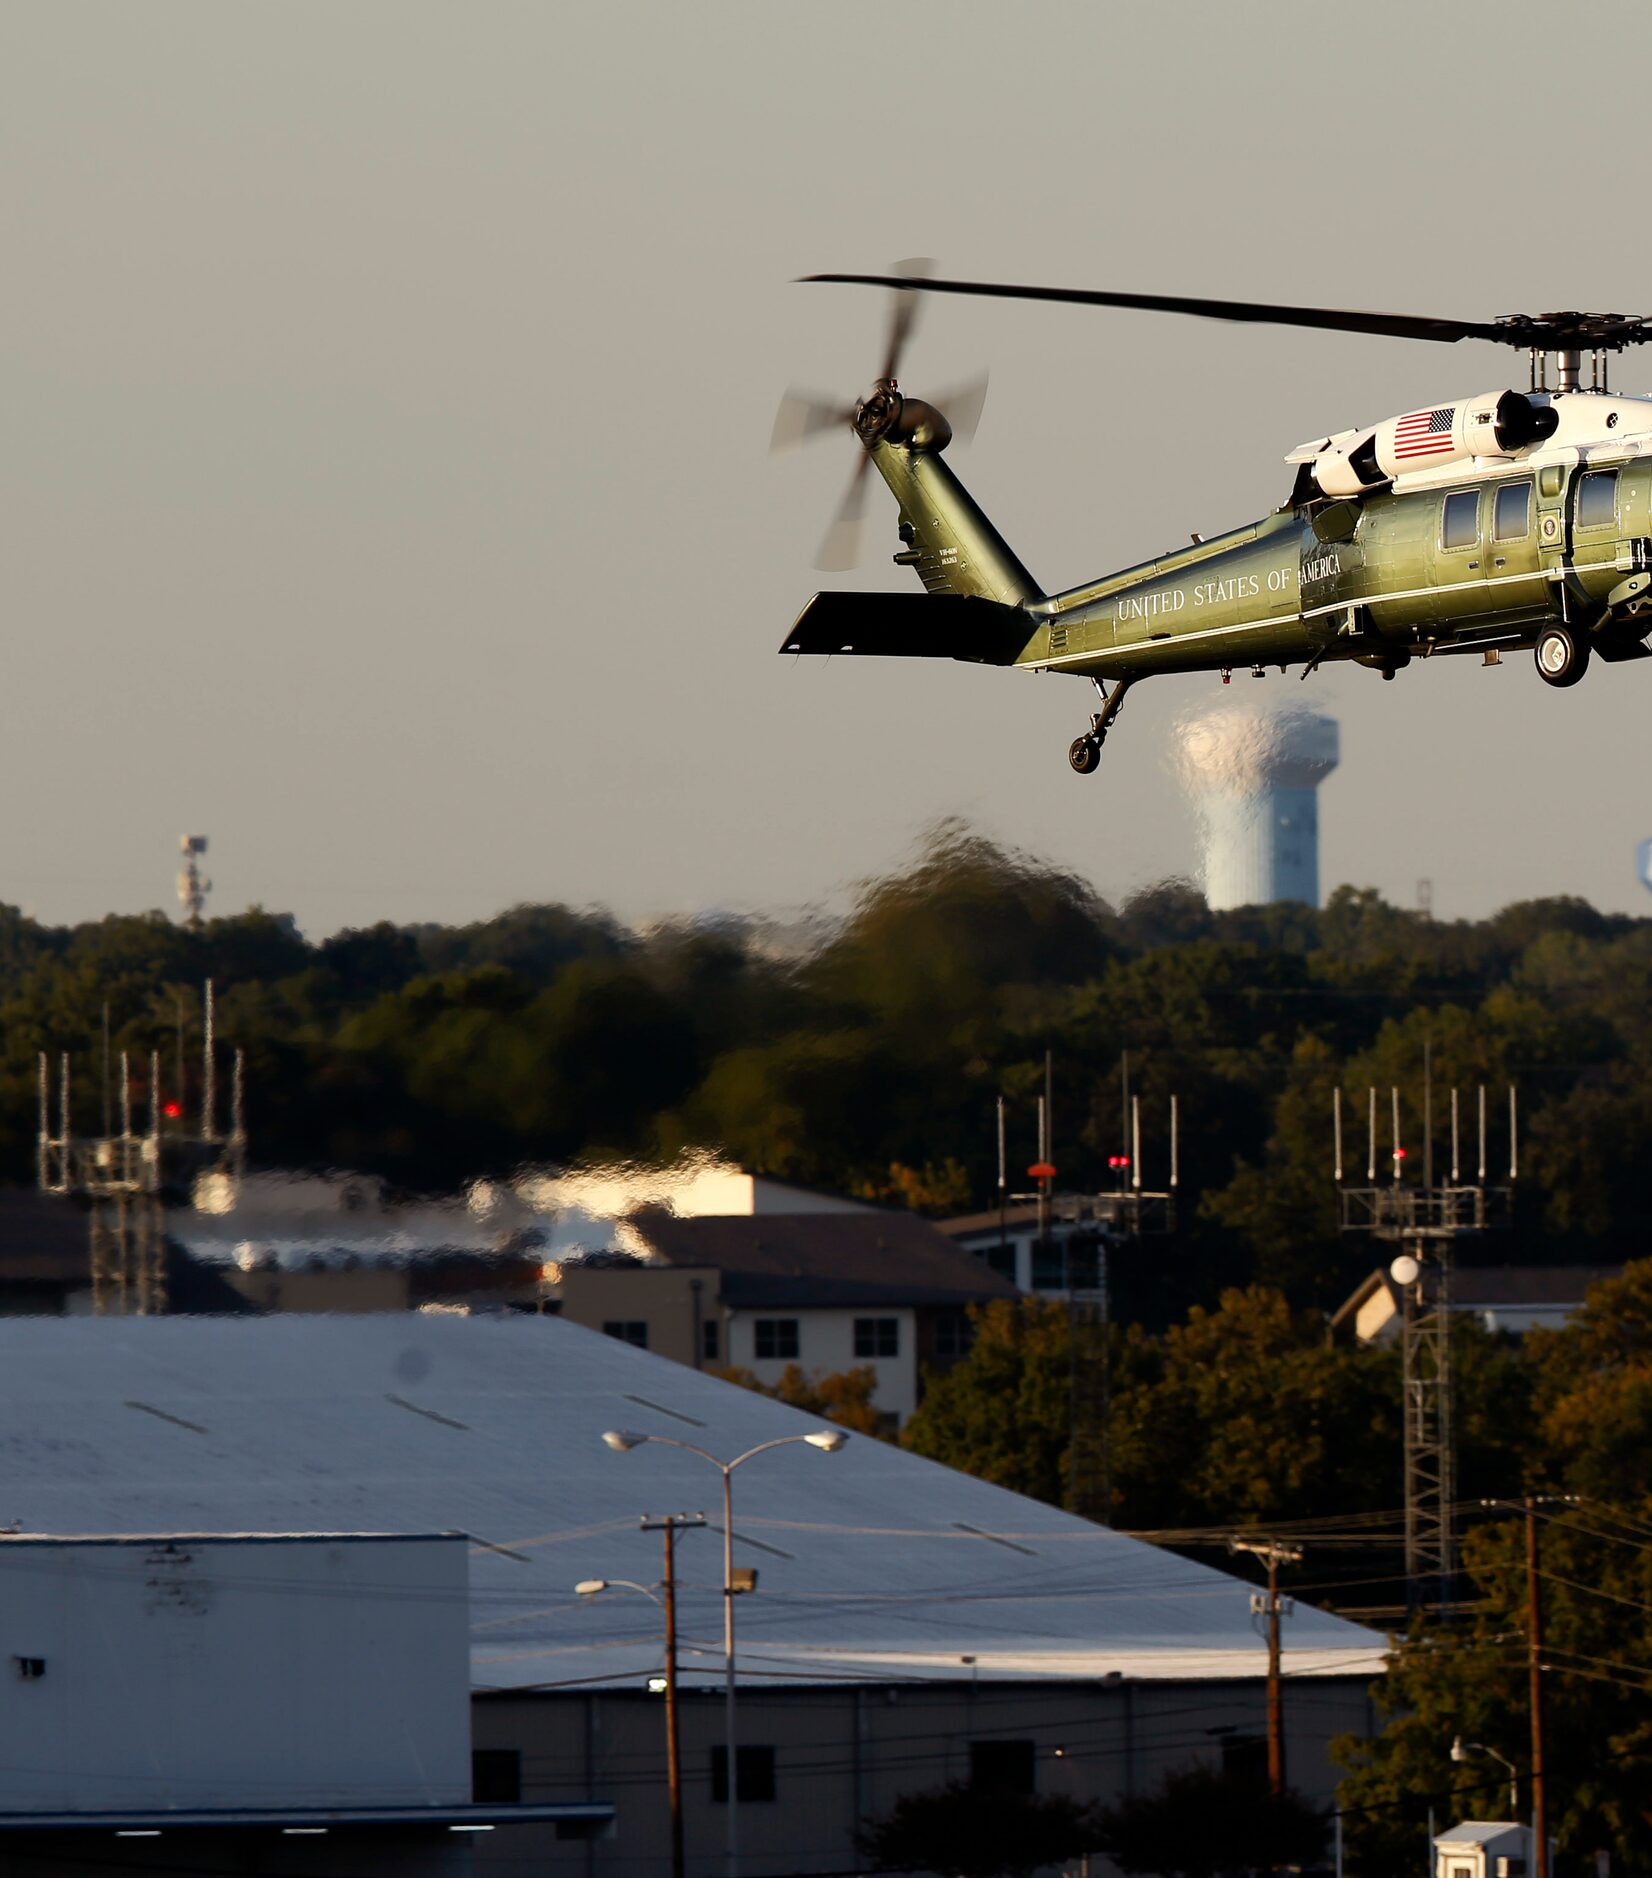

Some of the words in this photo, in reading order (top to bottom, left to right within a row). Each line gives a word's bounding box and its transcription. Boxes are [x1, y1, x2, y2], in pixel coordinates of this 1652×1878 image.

[1118, 589, 1185, 621] UNITED
[1194, 575, 1259, 606] STATES
[1267, 568, 1292, 591] OF
[1300, 553, 1341, 585] AMERICA
